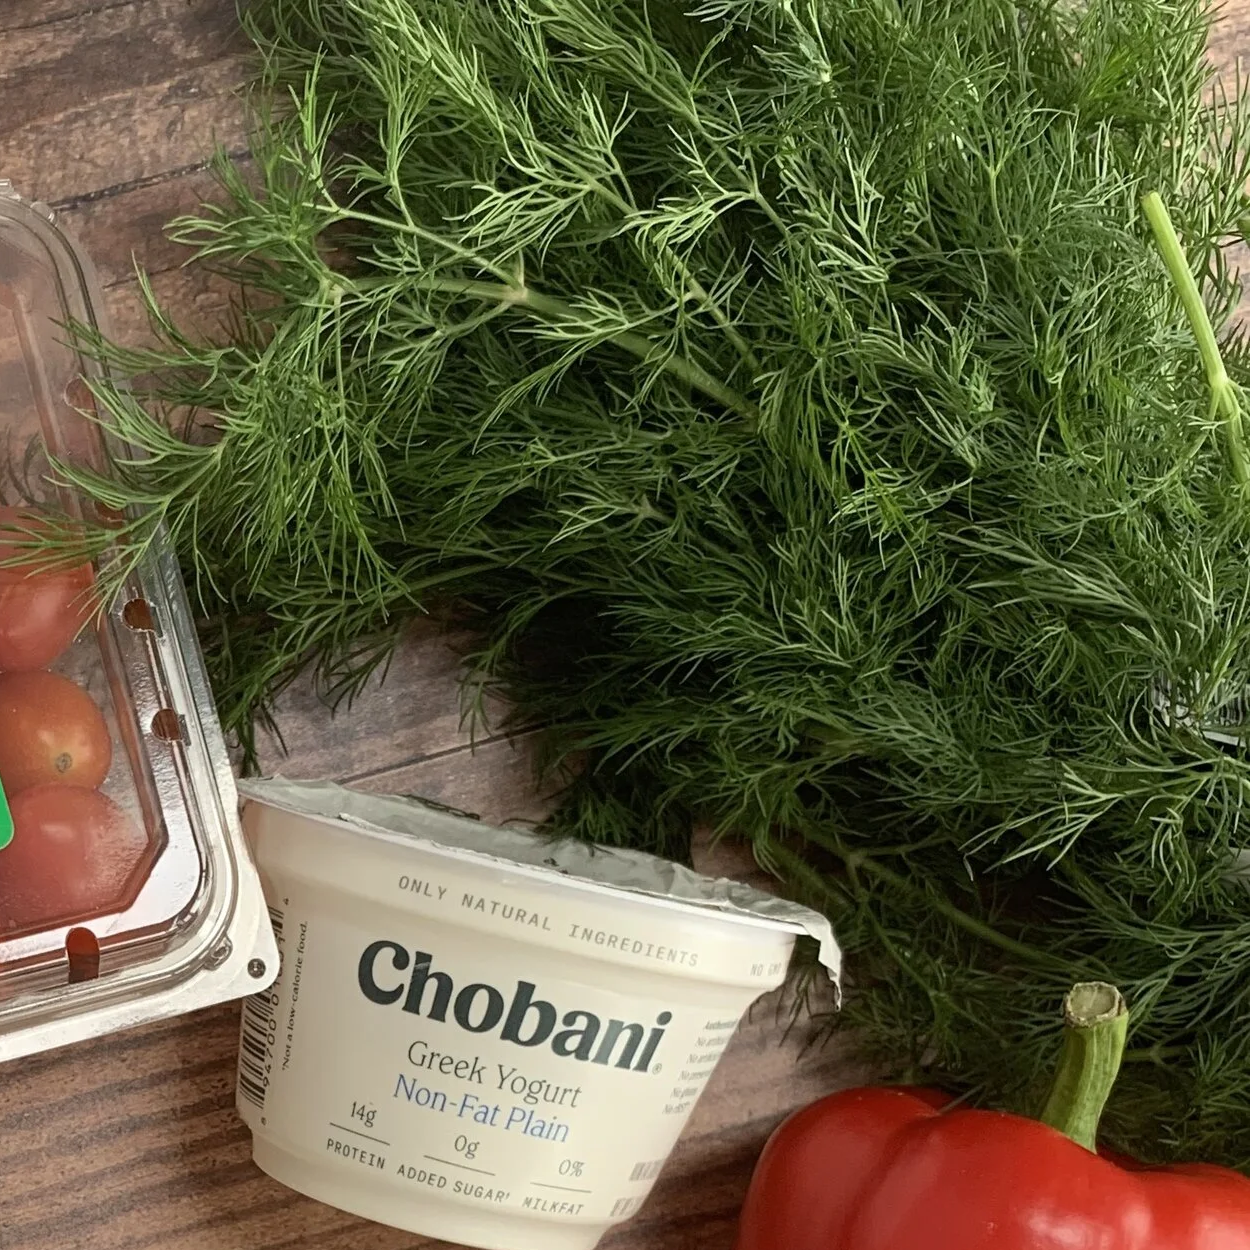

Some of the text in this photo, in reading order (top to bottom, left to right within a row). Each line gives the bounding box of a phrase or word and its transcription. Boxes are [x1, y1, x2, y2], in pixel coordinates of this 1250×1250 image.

[398, 875, 700, 968] ONLY NATURAL INGREDIENTS
[288, 957, 303, 1031] low-calorie
[357, 939, 673, 1075] Chobani
[406, 1040, 582, 1109] Greek Yogurt
[350, 1101, 378, 1128] 14g
[393, 1073, 570, 1144] Non-Fat Plain
[326, 1138, 386, 1170] PROTEIN
[454, 1135, 480, 1159] 0g
[396, 1164, 447, 1189] ADDED
[558, 1159, 585, 1178] 0%
[521, 1196, 585, 1217] MILKFAT
